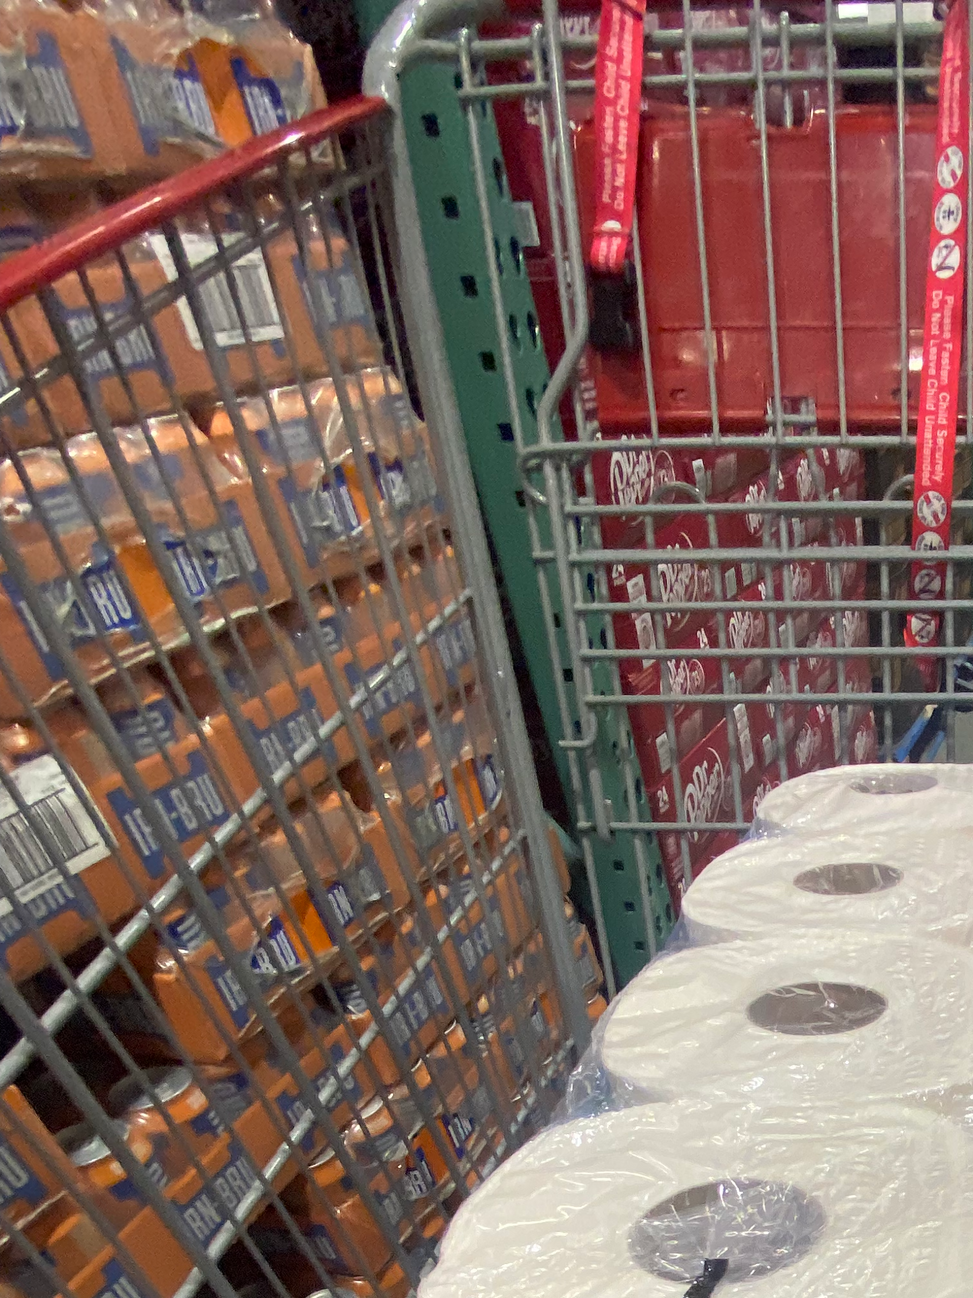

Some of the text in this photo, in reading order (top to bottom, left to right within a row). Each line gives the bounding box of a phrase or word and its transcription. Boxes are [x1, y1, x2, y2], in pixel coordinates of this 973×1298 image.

[921, 289, 943, 486] Do Not Leave Child Unattended
[931, 295, 955, 483] Please Fasten Child Securely
